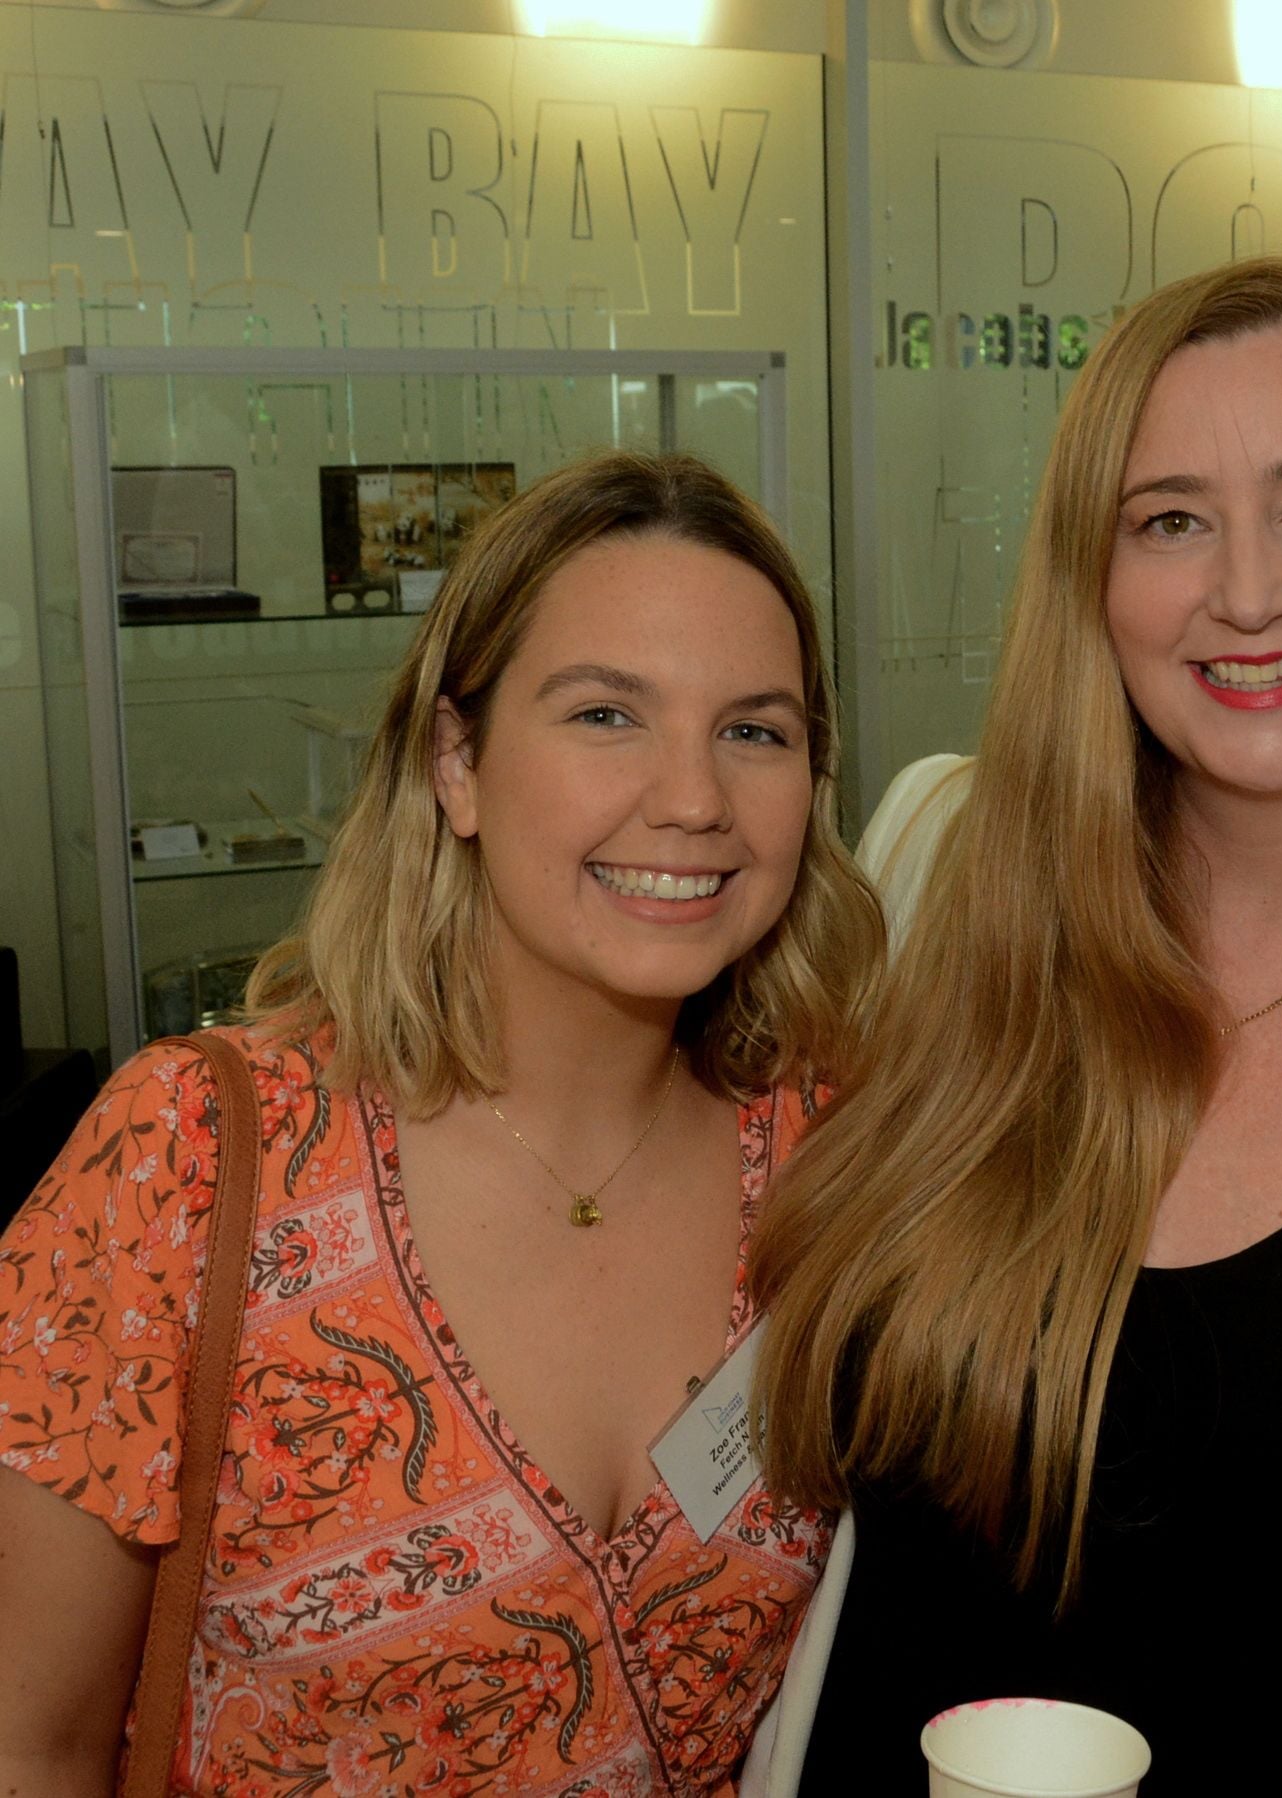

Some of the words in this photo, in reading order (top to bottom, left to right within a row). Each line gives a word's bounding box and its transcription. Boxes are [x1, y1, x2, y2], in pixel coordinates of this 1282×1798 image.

[375, 92, 770, 316] BAY
[709, 1438, 729, 1462] Zoe
[720, 1440, 743, 1469] Fetch
[742, 1432, 750, 1442] N
[712, 1455, 748, 1496] Wellness
